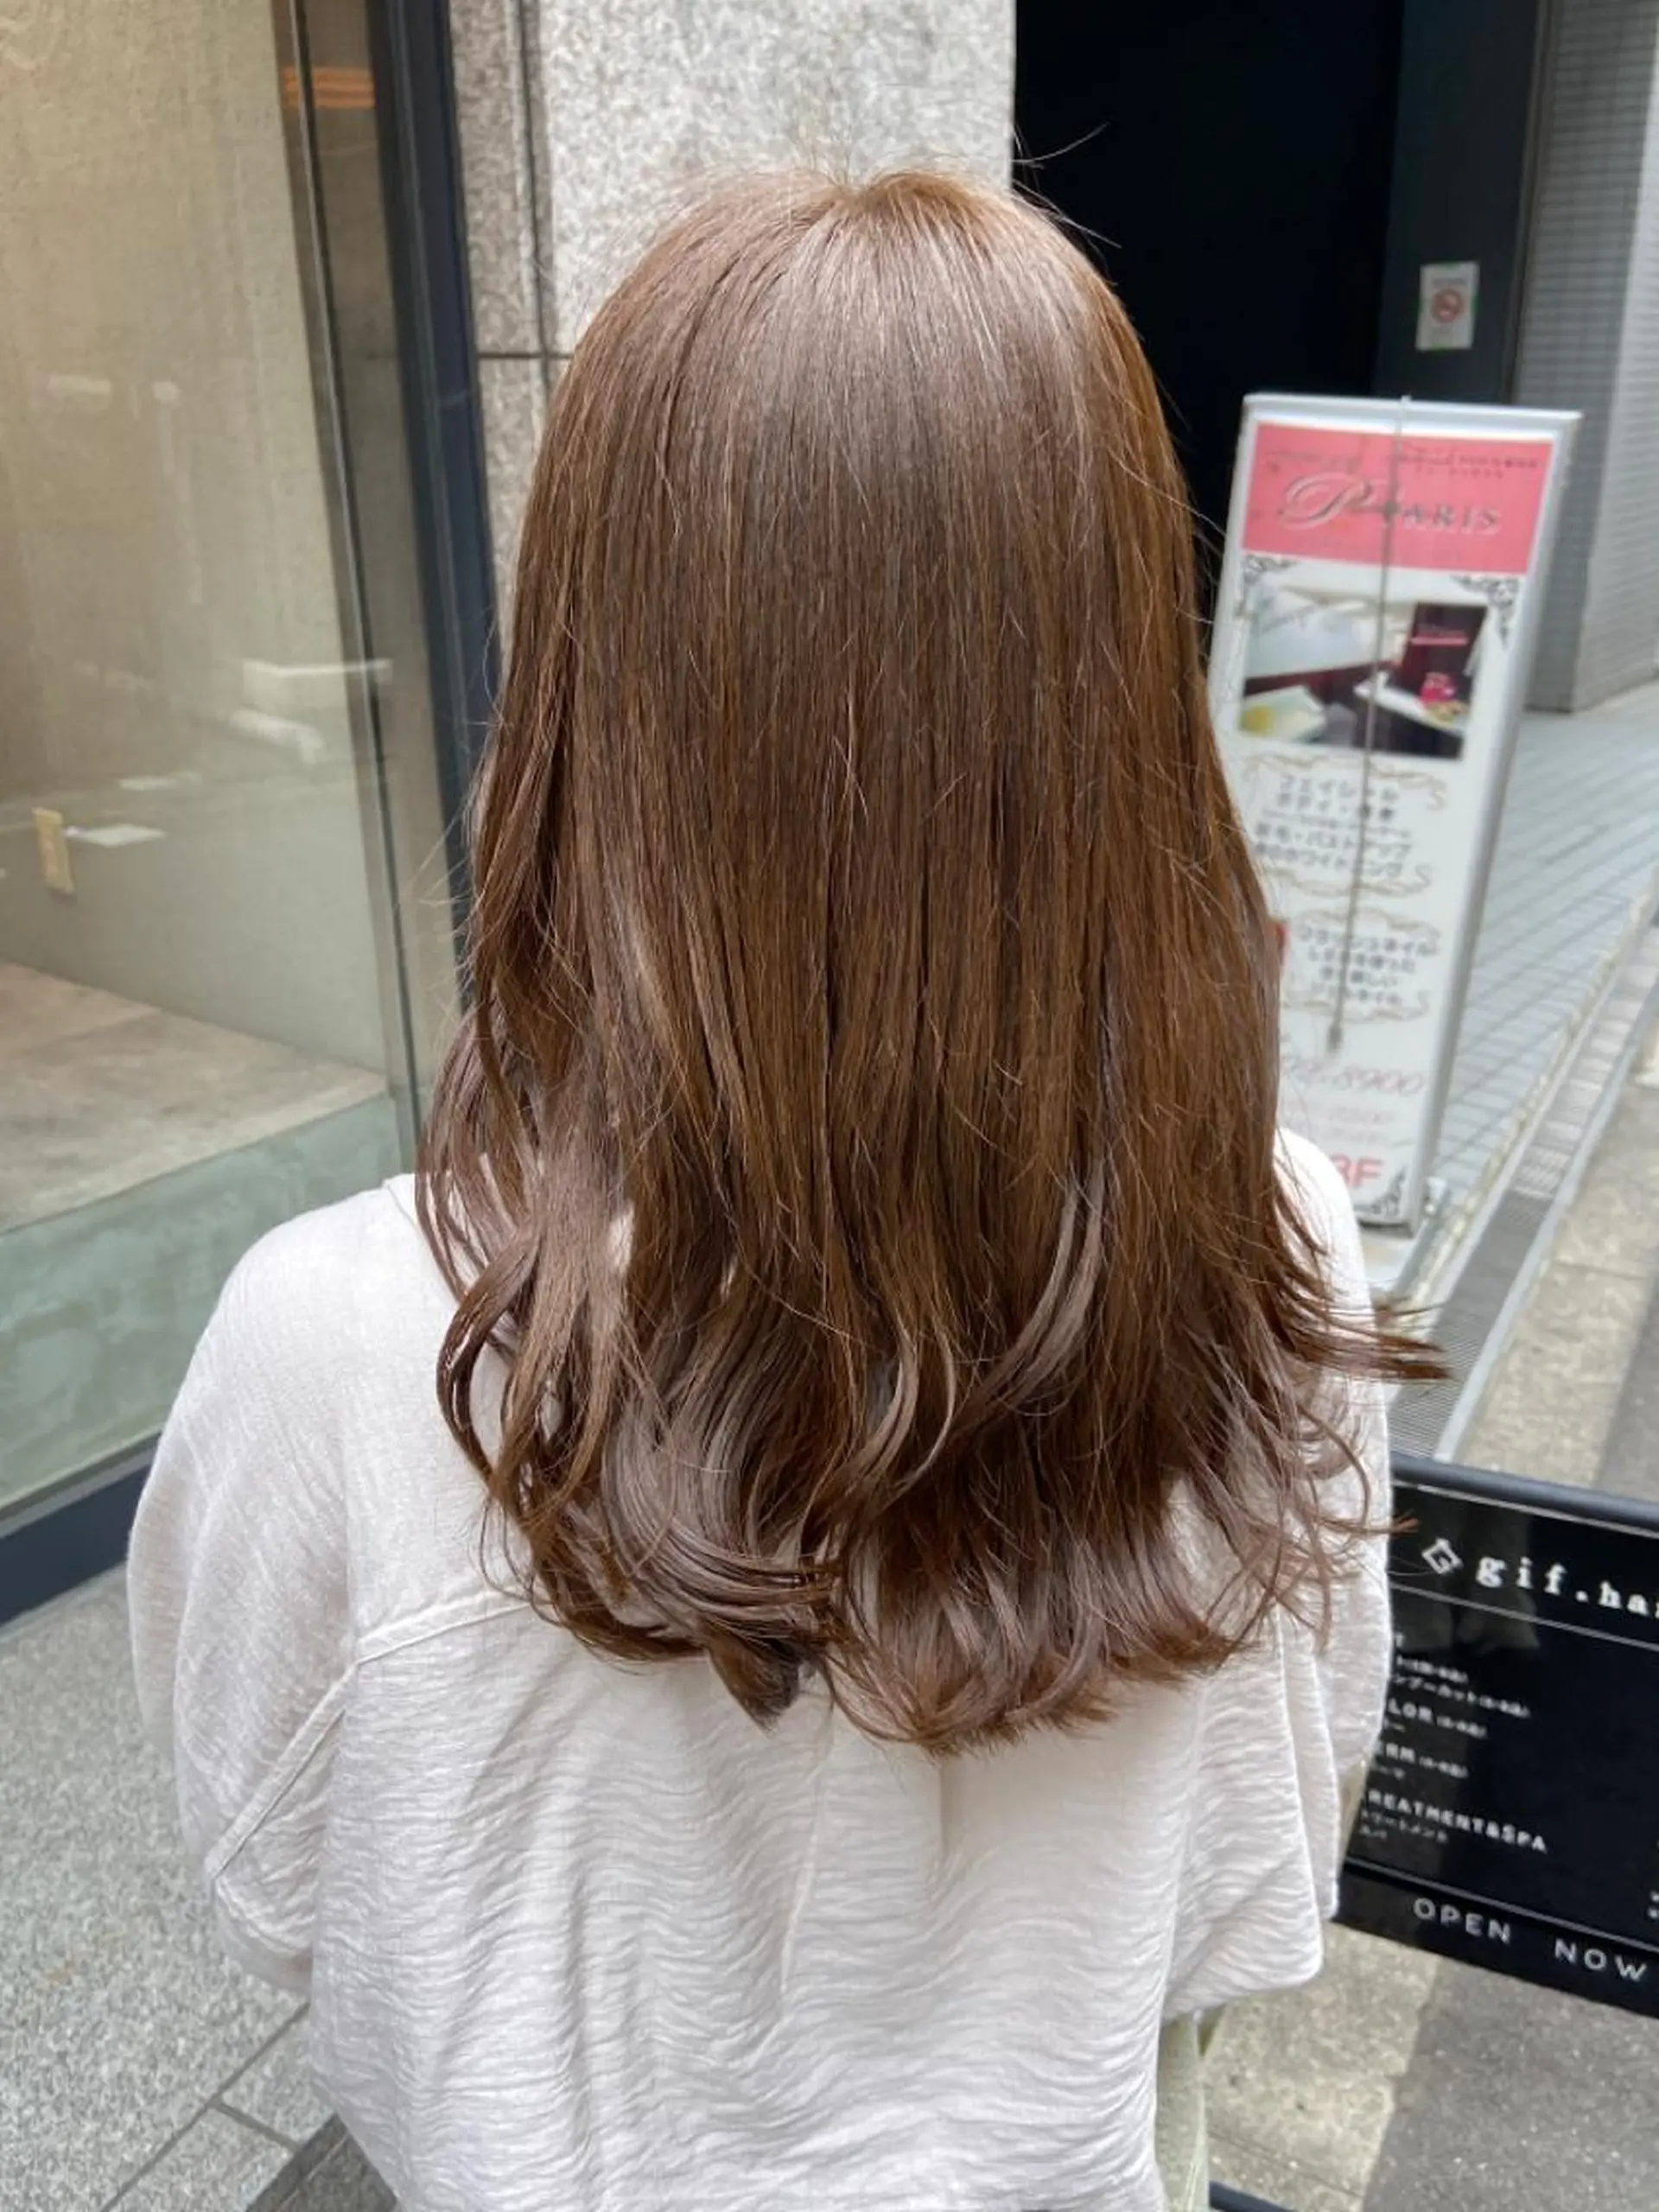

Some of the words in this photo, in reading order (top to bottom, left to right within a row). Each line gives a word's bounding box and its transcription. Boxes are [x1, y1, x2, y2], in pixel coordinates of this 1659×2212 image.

[1475, 1556, 1659, 1619] gif.ha
[1413, 1897, 1512, 1944] OPEN
[1554, 1938, 1648, 1982] NOW
